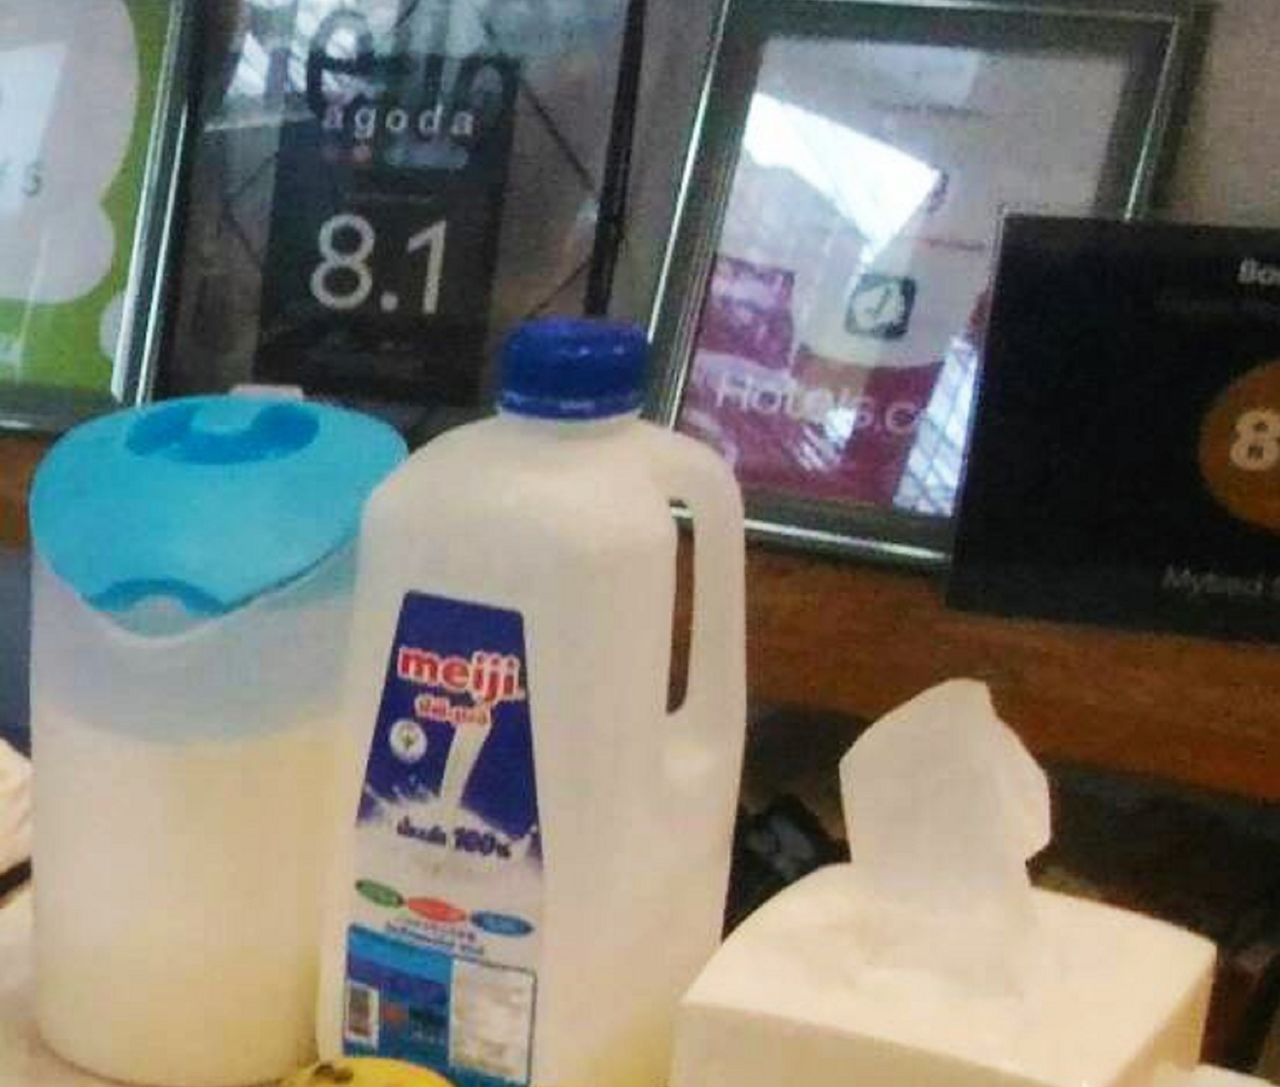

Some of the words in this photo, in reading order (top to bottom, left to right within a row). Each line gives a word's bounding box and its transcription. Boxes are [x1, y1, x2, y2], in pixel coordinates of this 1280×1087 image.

[321, 97, 476, 139] agoda
[309, 213, 447, 315] 8.1
[398, 646, 522, 704] meiji
